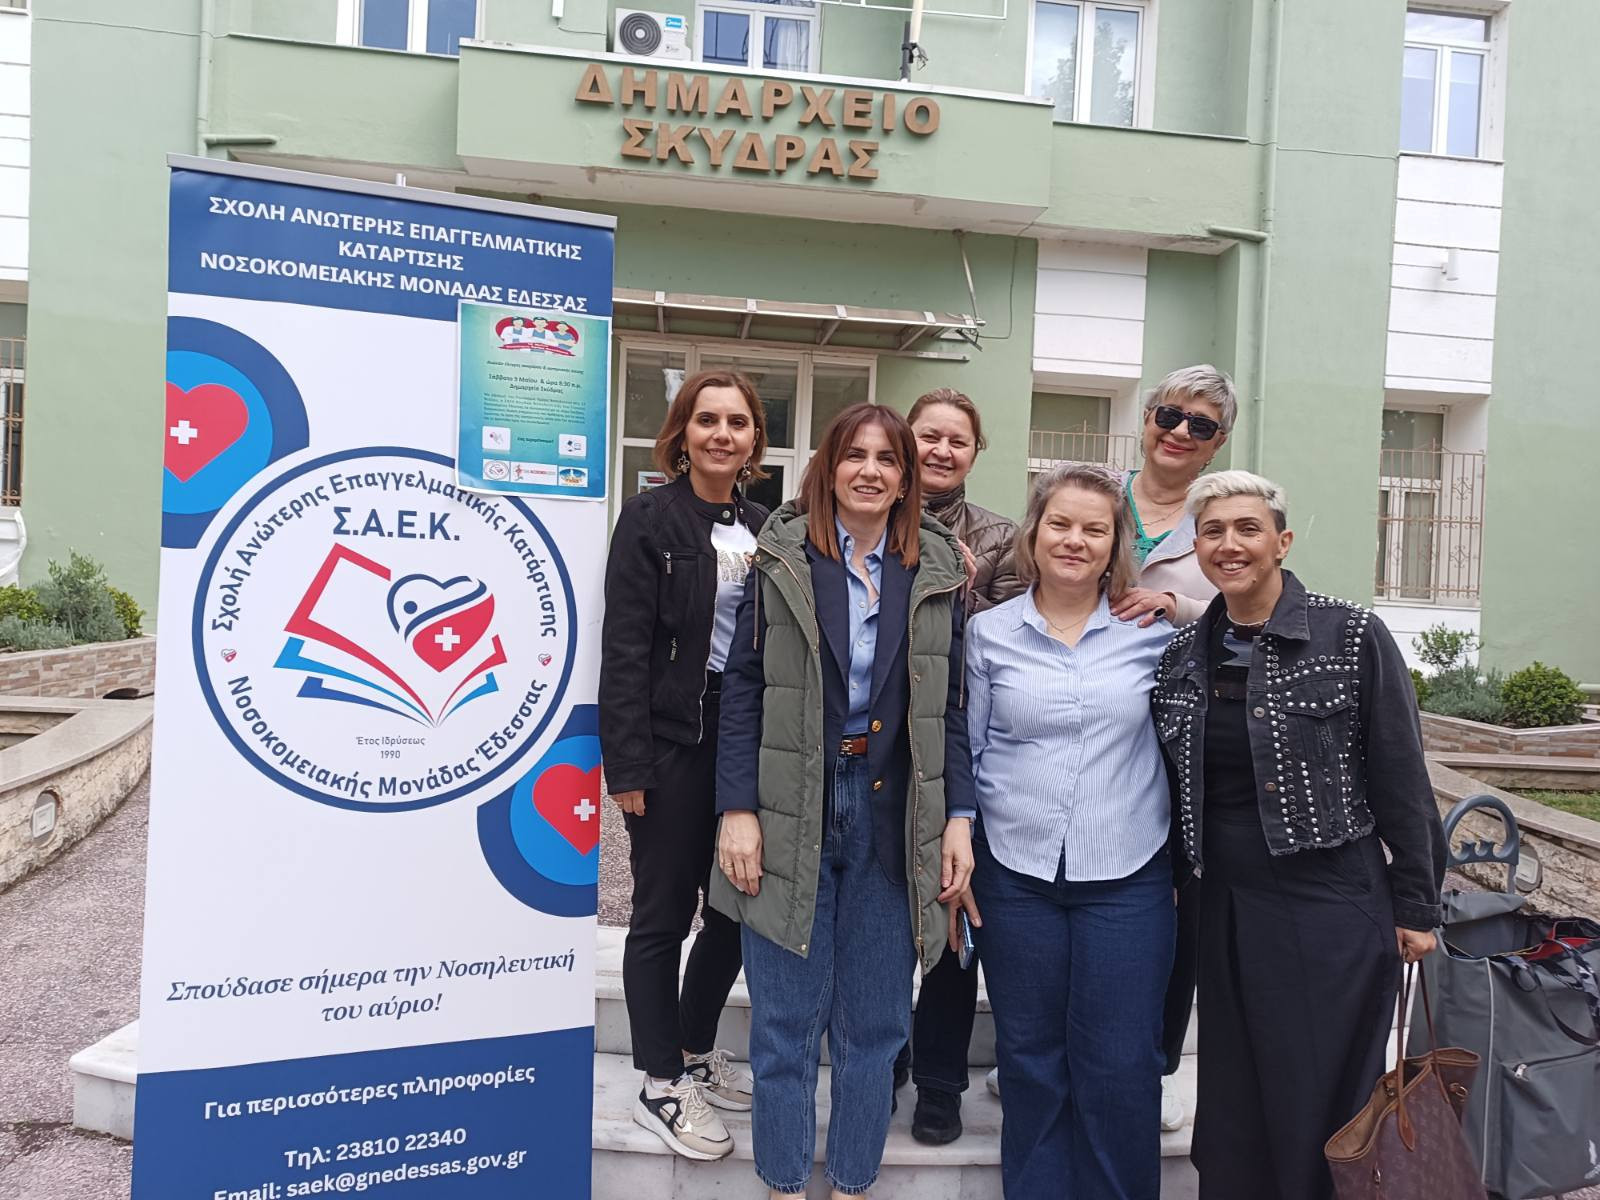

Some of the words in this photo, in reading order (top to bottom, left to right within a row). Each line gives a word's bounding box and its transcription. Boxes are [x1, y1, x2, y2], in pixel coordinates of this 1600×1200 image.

[575, 63, 941, 135] ΔΗΜΑΡΧΕΙΟ
[620, 118, 880, 179] ΣΚΥΔΡΑΣ
[209, 196, 286, 222] ΣΧΟΛΗ
[290, 207, 405, 237] ΑΝΩΤΕΡΗΣ
[409, 222, 582, 261] ΕΠΑΓΓΕΛΜΑΤΙΚΗΣ
[338, 241, 464, 271] ΚΑΤΑΡΤΙΣΗΣ
[200, 252, 395, 289] ΝΟΣΟΚΟΜΕΙΑΚΗΣ
[400, 275, 503, 302] ΜΟΝΑΔΑΣ
[508, 288, 588, 312] ΕΔΕΣΣΑΣ
[333, 506, 460, 541] Σ.Α.Ε.Κ.
[212, 565, 251, 631] Σχολή
[236, 483, 330, 567] Ανώτερης
[329, 470, 506, 530] Επαγγελματικής
[503, 523, 557, 638] Κατάρτισης
[227, 675, 372, 798] Νοσοκομειακής
[378, 755, 481, 797] Μονάδας
[474, 679, 548, 762] Έδεσσας
[356, 736, 380, 746] Έτος
[381, 735, 426, 747] Ιδρύσεως
[380, 750, 401, 759] 1990
[166, 974, 294, 1002] Σπούδασε
[299, 966, 388, 995] σήμερα
[393, 963, 433, 987] την
[435, 947, 576, 980] Νοσηλευτική
[320, 1002, 362, 1022] του
[368, 992, 443, 1020] αύριο!
[204, 1099, 241, 1120] Για
[246, 1079, 399, 1116] περισσότερες
[402, 1064, 536, 1097] πληροφορίες
[214, 1182, 281, 1200] Email:
[286, 1147, 528, 1197] saek@gnedessas.gov.gr
[284, 1146, 331, 1170] Τηλ:
[336, 1136, 400, 1161] 23810
[404, 1126, 467, 1152] 22340
